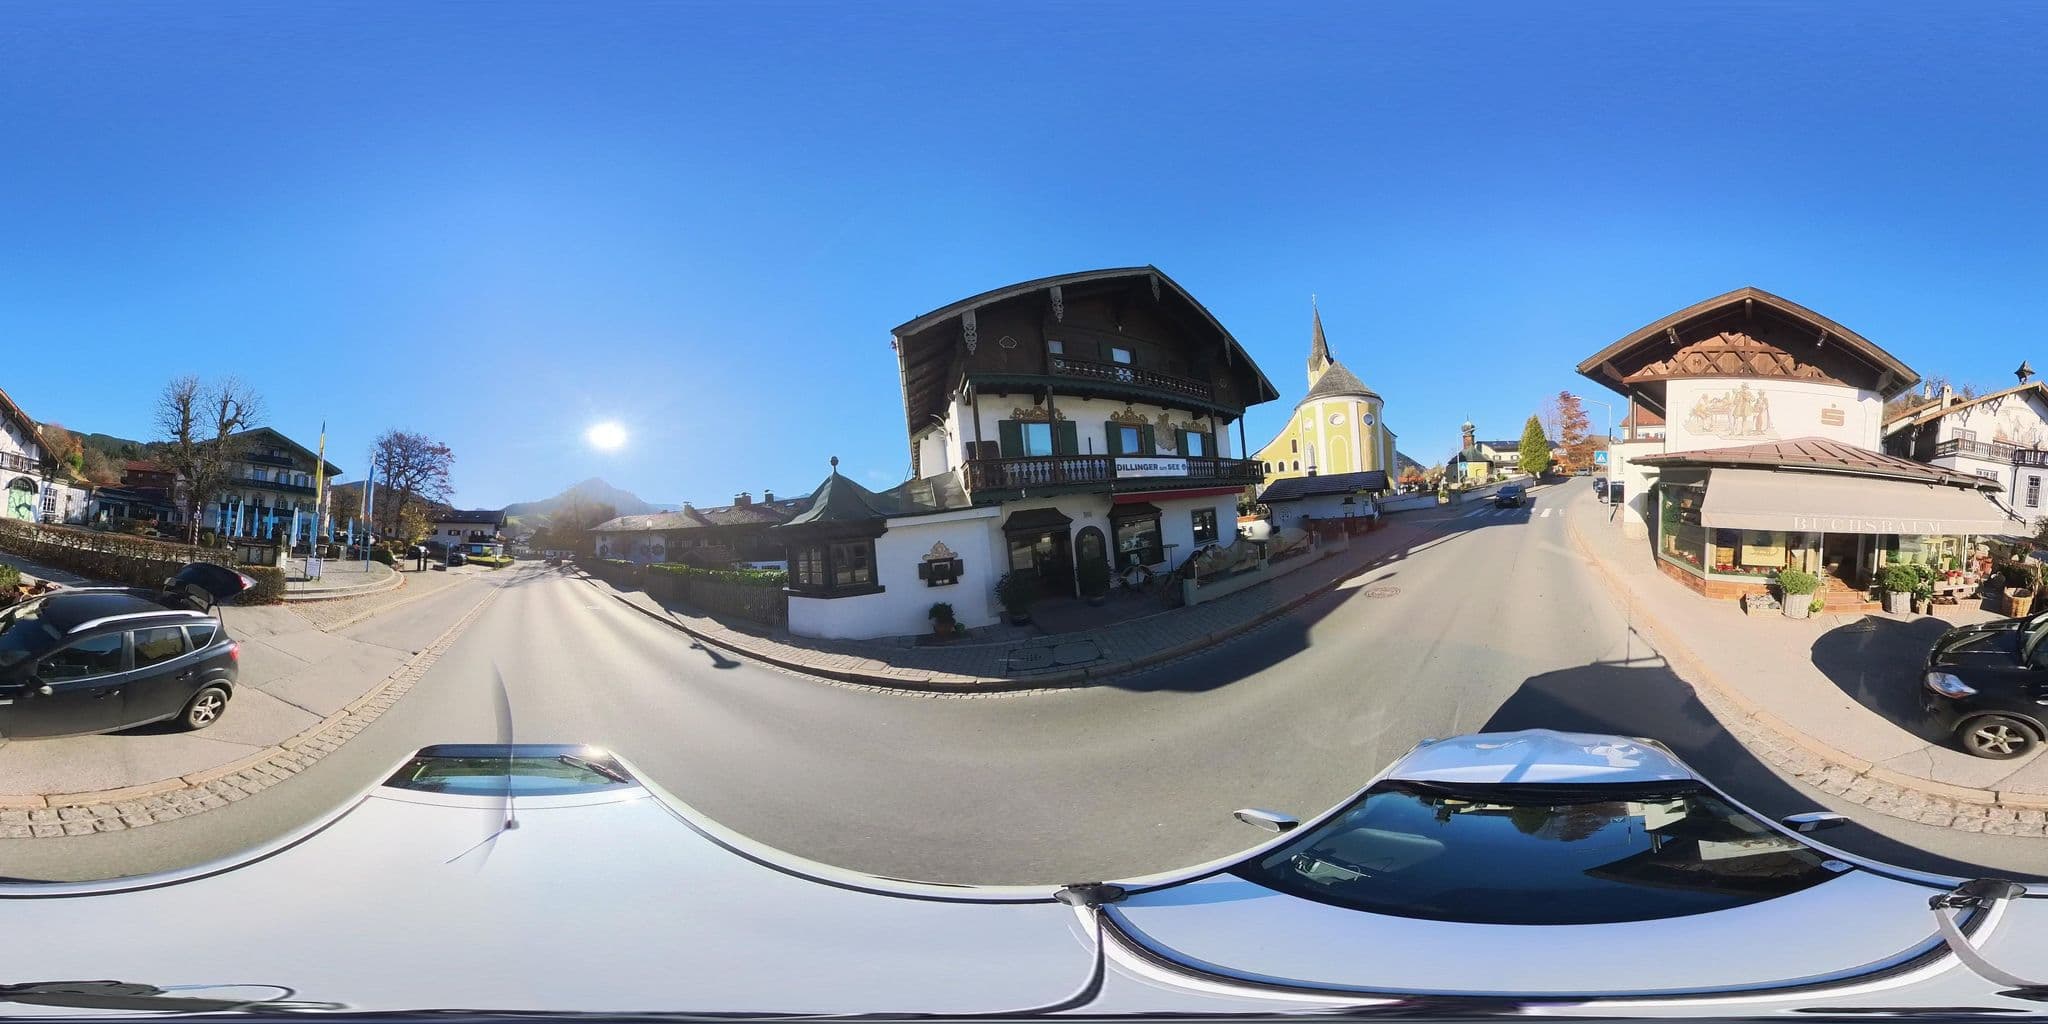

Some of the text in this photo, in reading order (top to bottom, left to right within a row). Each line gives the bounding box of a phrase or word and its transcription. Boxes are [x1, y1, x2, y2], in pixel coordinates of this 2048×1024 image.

[1117, 463, 1159, 472] DILLINGER
[1167, 463, 1180, 471] SEE
[1793, 517, 1943, 533] BUCHSBAUM
